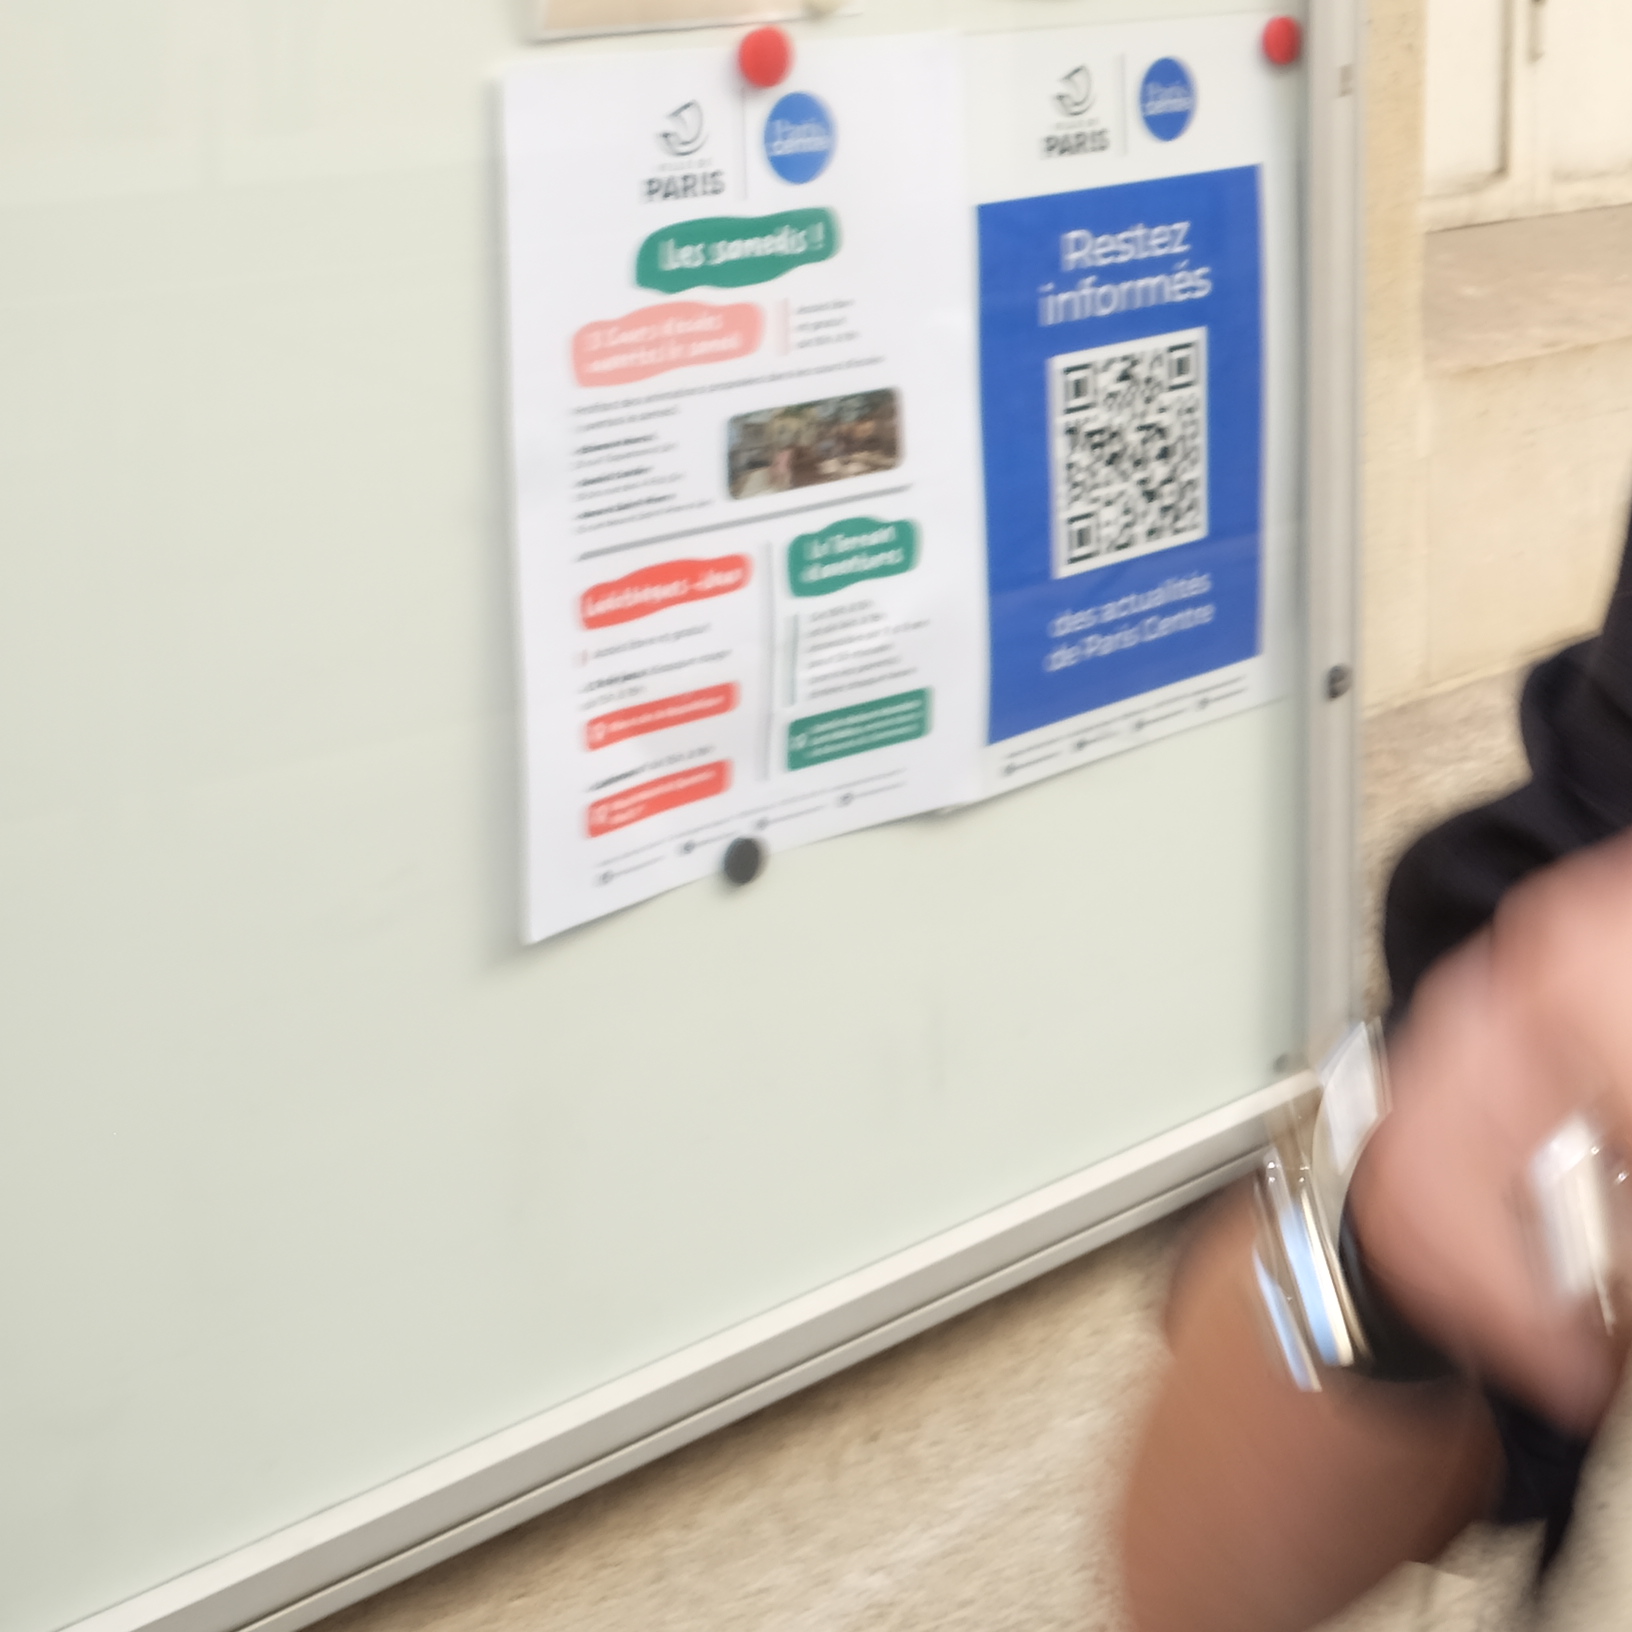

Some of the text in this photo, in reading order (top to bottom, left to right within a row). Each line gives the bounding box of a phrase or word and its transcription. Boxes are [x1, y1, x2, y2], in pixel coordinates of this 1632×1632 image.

[1039, 128, 1110, 158] PARIS
[644, 169, 727, 203] PARIS
[1060, 221, 1192, 271] Restez
[1036, 260, 1212, 327] informés
